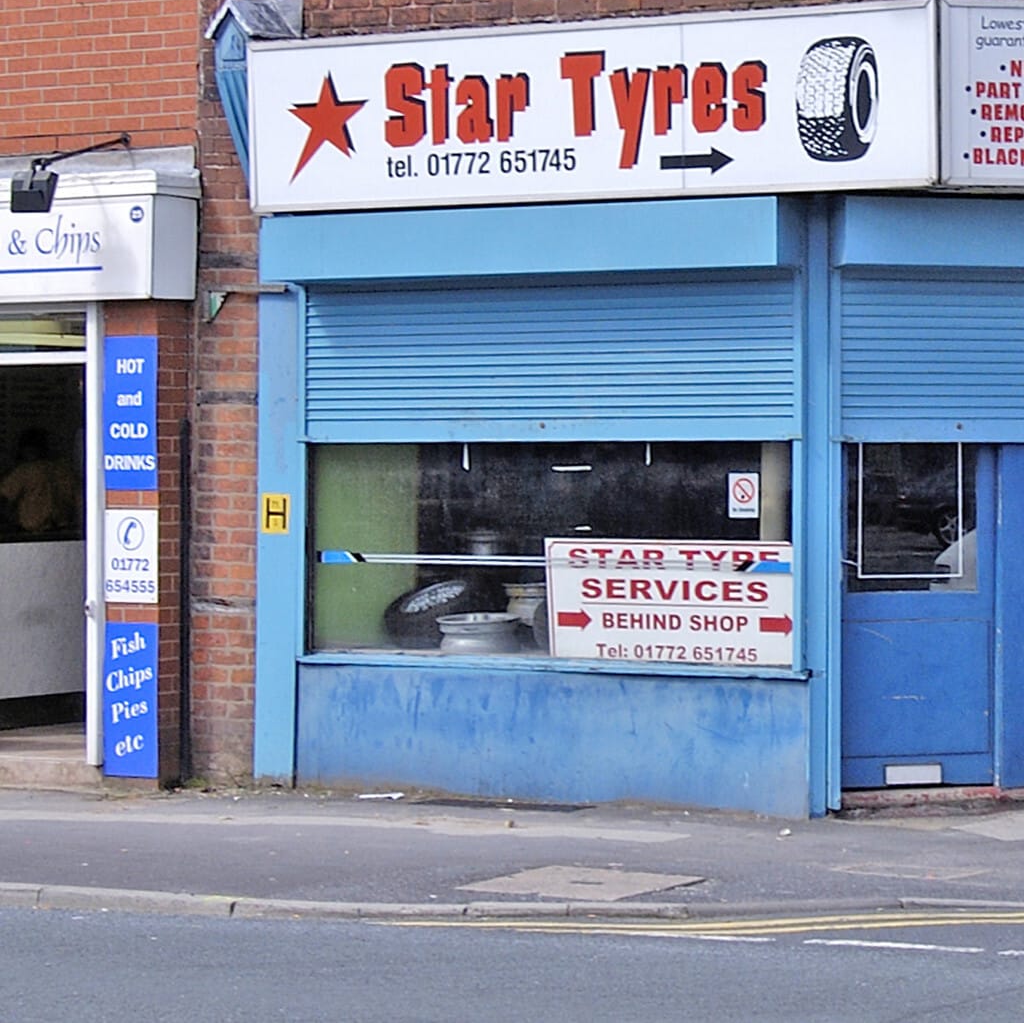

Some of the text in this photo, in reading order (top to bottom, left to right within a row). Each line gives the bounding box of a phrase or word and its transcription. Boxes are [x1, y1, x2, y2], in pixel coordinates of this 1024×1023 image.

[976, 82, 1021, 98] PART
[384, 50, 768, 170] Star Tyres
[387, 148, 576, 178] tel. 01772 651745
[8, 214, 101, 264] & Chips
[116, 358, 145, 374] HOT
[116, 389, 143, 407] and
[109, 422, 148, 439] COLD
[104, 454, 156, 471] DRINKS
[266, 497, 287, 529] H
[111, 558, 149, 572] 01772
[568, 548, 665, 570] STAR
[105, 579, 155, 594] 654555
[581, 578, 769, 602] SERVICES
[602, 612, 749, 632] BEHIND SHOP
[111, 631, 147, 660] Fish
[597, 643, 758, 662] Tel: 01772 651745
[106, 664, 153, 692] Chips
[111, 700, 149, 724] Pies
[115, 733, 144, 757] etc
